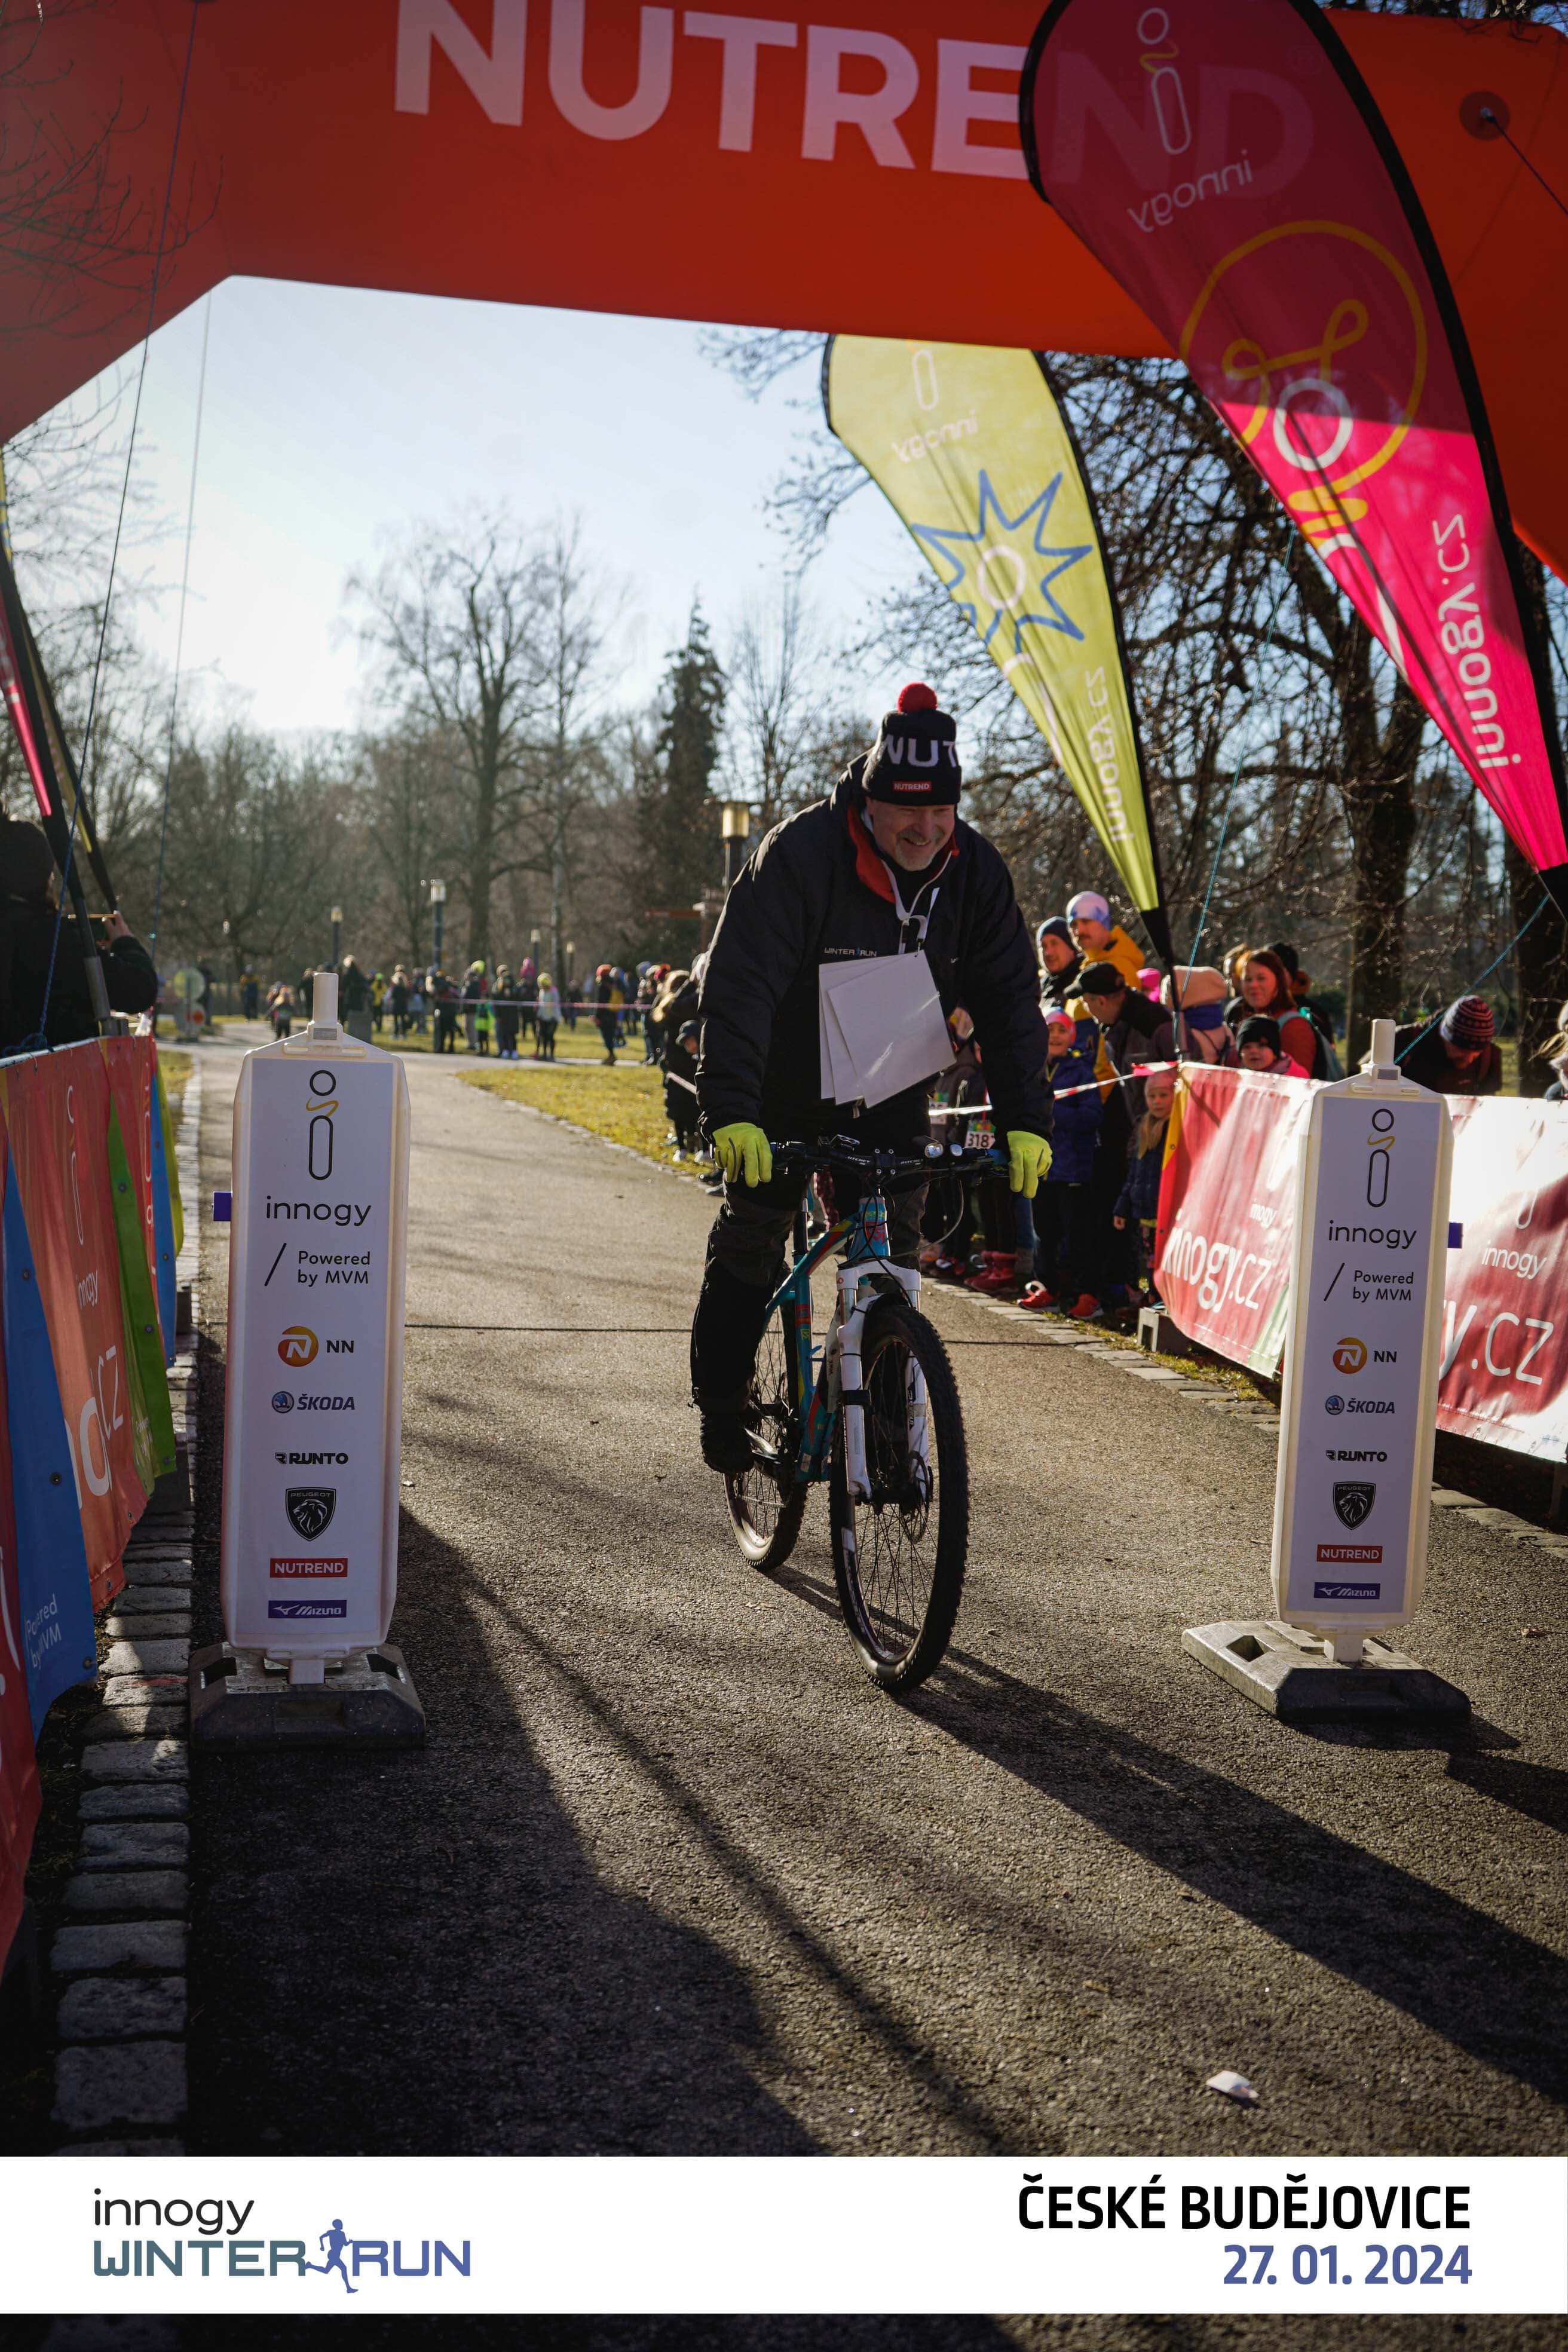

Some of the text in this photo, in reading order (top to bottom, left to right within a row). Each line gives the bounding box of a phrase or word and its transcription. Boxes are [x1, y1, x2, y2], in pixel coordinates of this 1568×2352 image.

[967, 1134, 990, 1148] 318
[266, 1195, 372, 1227] innogy
[1328, 1220, 1417, 1250] innogy
[298, 1250, 370, 1266] Powered
[1481, 1240, 1547, 1279] innogy
[298, 1269, 369, 1288] by MVM
[1353, 1270, 1414, 1285] Powered
[1352, 1286, 1411, 1303] by MVM
[326, 1340, 355, 1353] NN
[1374, 1350, 1397, 1363] NN
[296, 1393, 355, 1411] ŠKODA
[1346, 1397, 1395, 1414] ŠKODA
[289, 1452, 349, 1465] RUNTO
[1337, 1450, 1388, 1462] RUNTO
[1321, 1548, 1380, 1560] NUTREND
[274, 1563, 344, 1574] NUTREND
